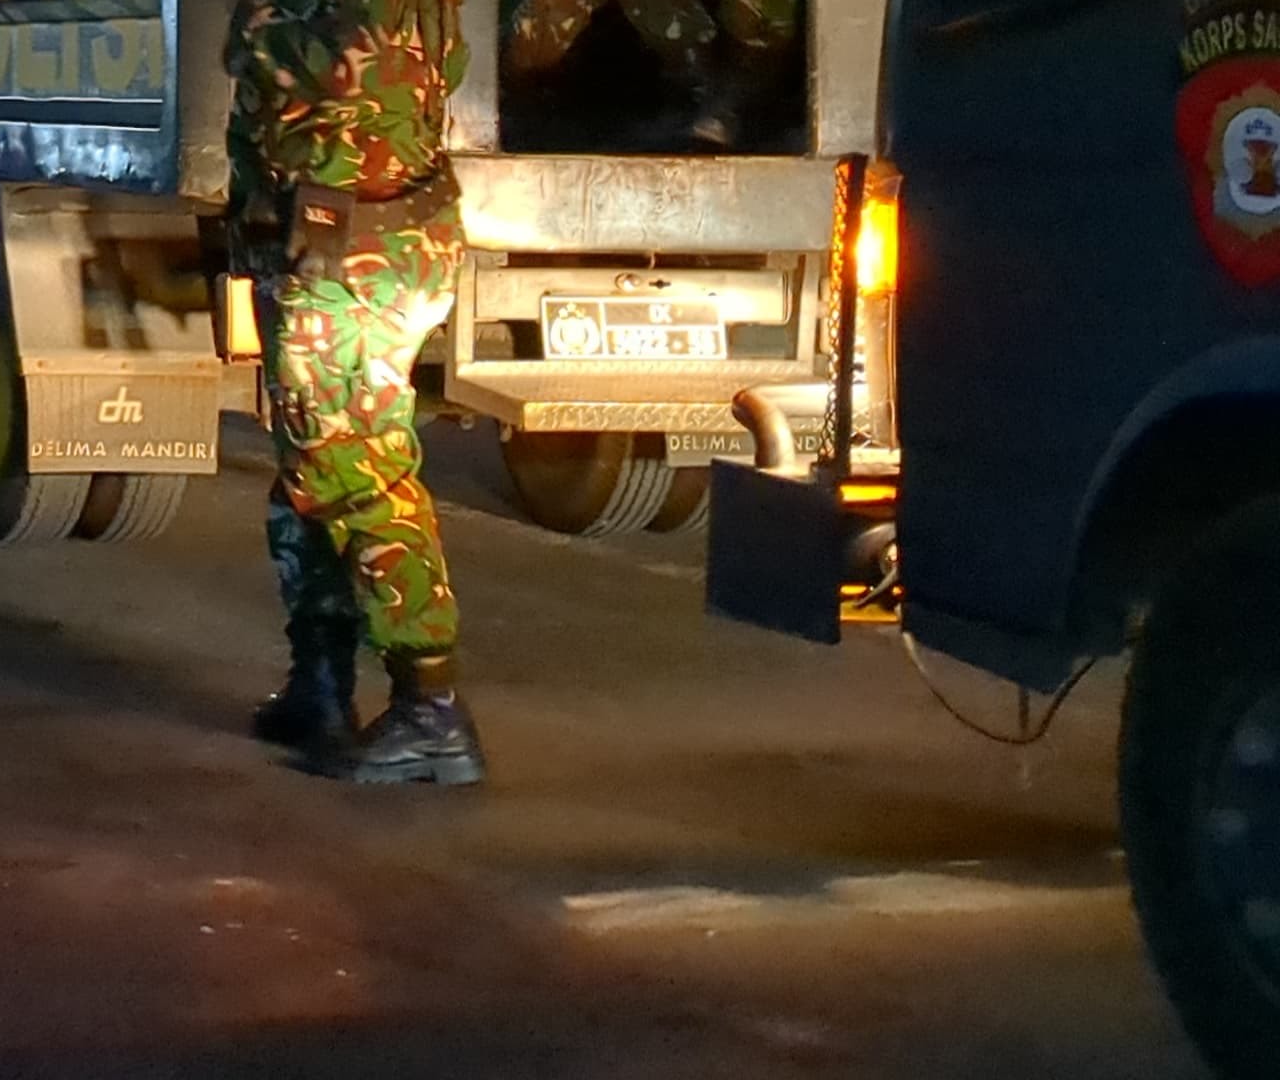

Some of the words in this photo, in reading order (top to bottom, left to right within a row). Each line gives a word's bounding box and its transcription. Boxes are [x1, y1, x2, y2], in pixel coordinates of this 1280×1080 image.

[1179, 11, 1247, 73] KORPS
[31, 441, 107, 458] DELIMA
[121, 441, 216, 460] MANDIRI
[670, 435, 741, 451] DELIMA
